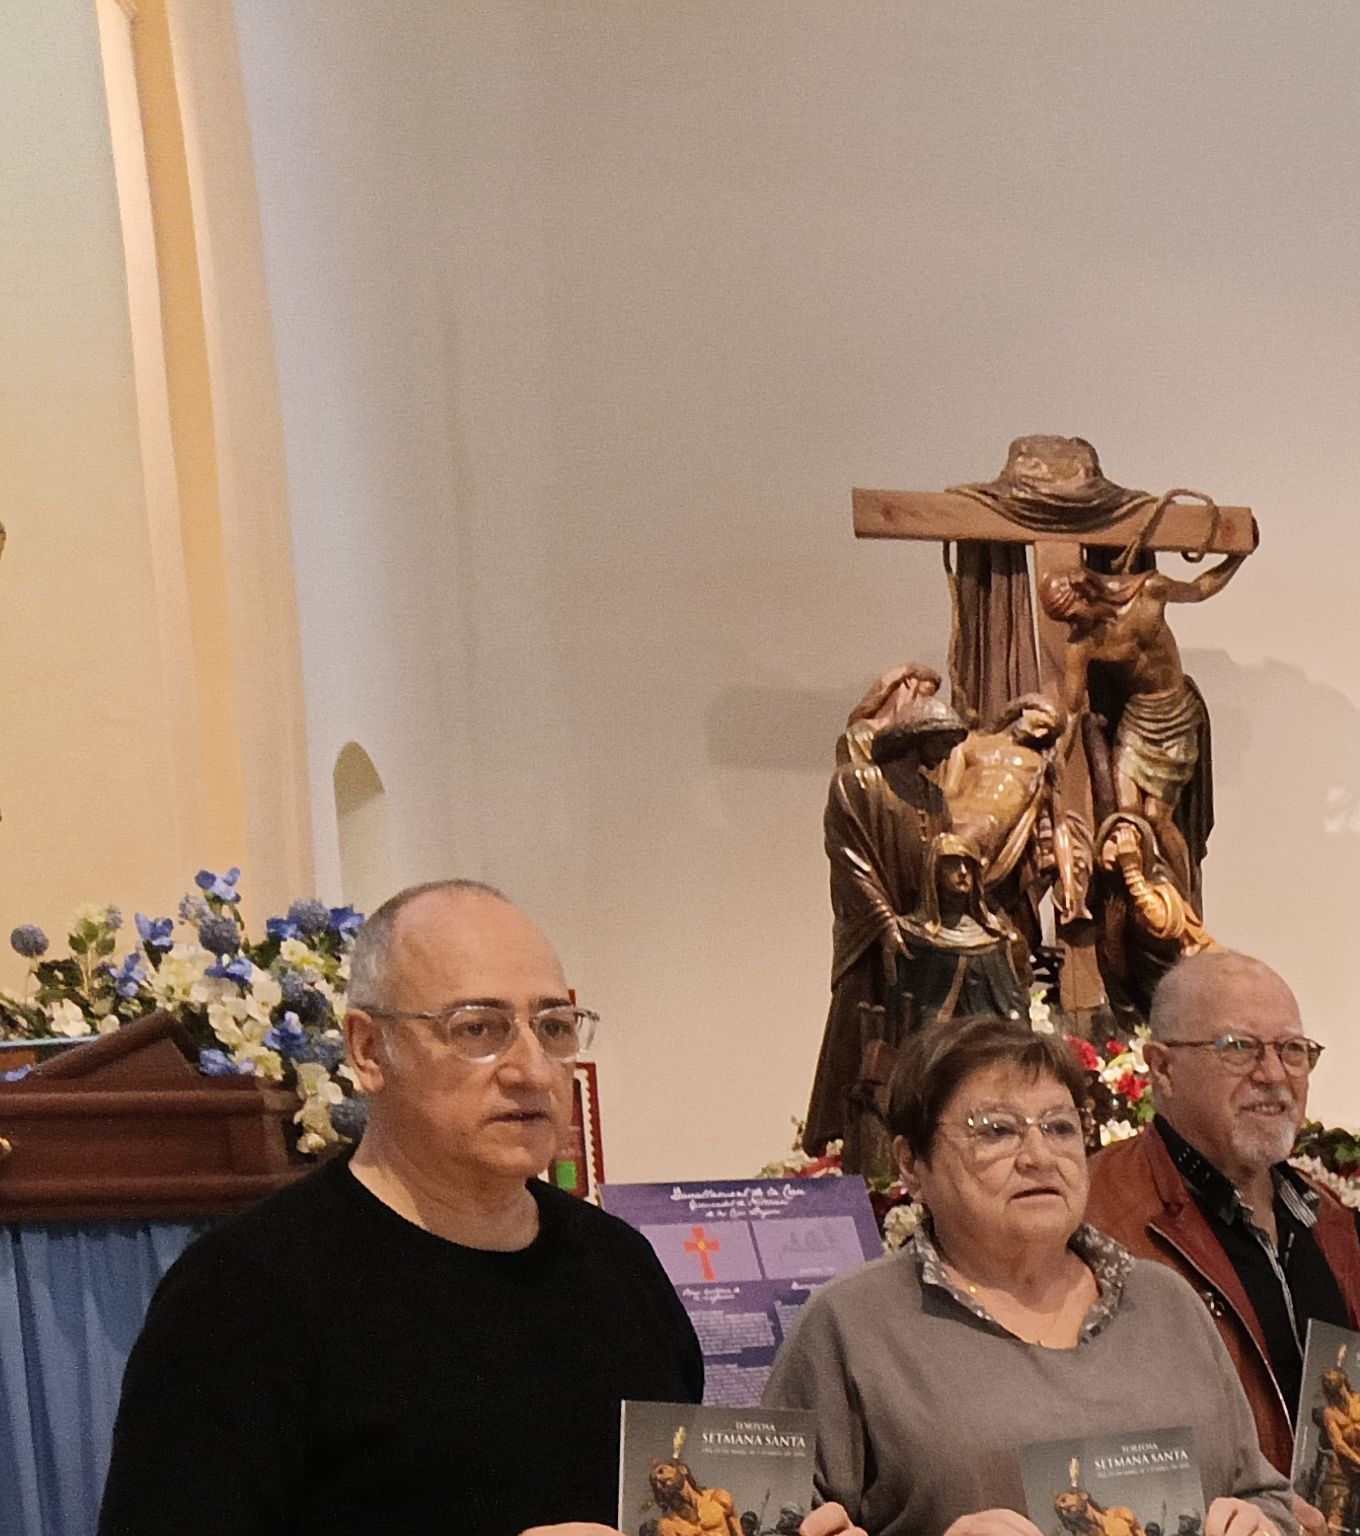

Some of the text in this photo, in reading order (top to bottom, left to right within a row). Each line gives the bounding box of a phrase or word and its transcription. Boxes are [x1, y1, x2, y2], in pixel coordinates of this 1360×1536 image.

[702, 1431, 806, 1449] SETMANA SANTA
[1094, 1453, 1150, 1471] SETMANA
[1150, 1448, 1189, 1463] SANTA
